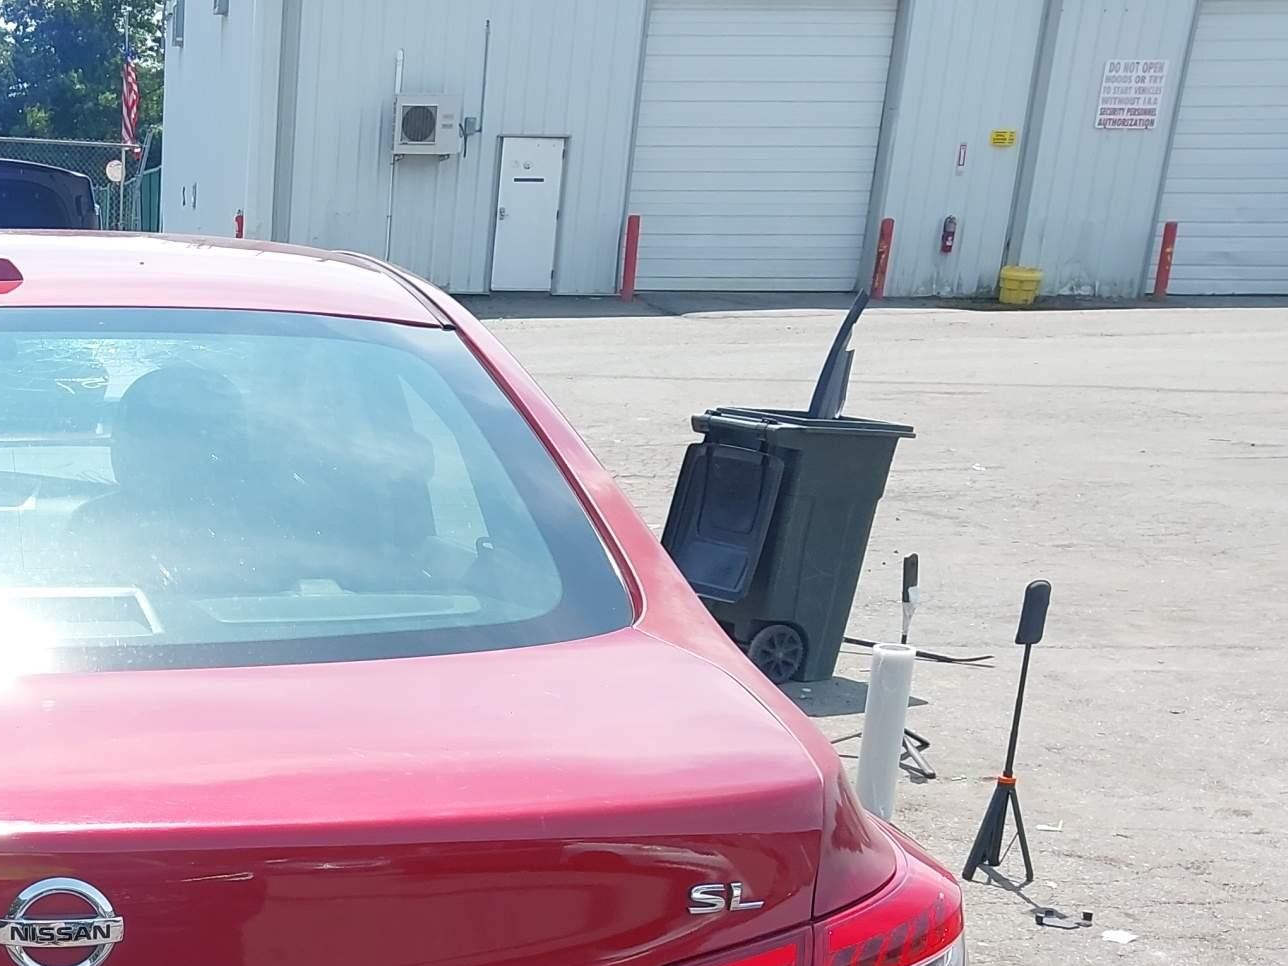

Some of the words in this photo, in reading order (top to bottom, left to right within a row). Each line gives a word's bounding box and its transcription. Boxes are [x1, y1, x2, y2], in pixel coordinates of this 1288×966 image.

[1109, 62, 1121, 73] DO
[1123, 62, 1140, 73] NOT
[1142, 62, 1165, 73] OPEN
[1134, 75, 1146, 84] OR
[1098, 118, 1155, 127] AUTHORIZATION
[688, 882, 764, 914] SL
[10, 924, 111, 941] NISSAN
